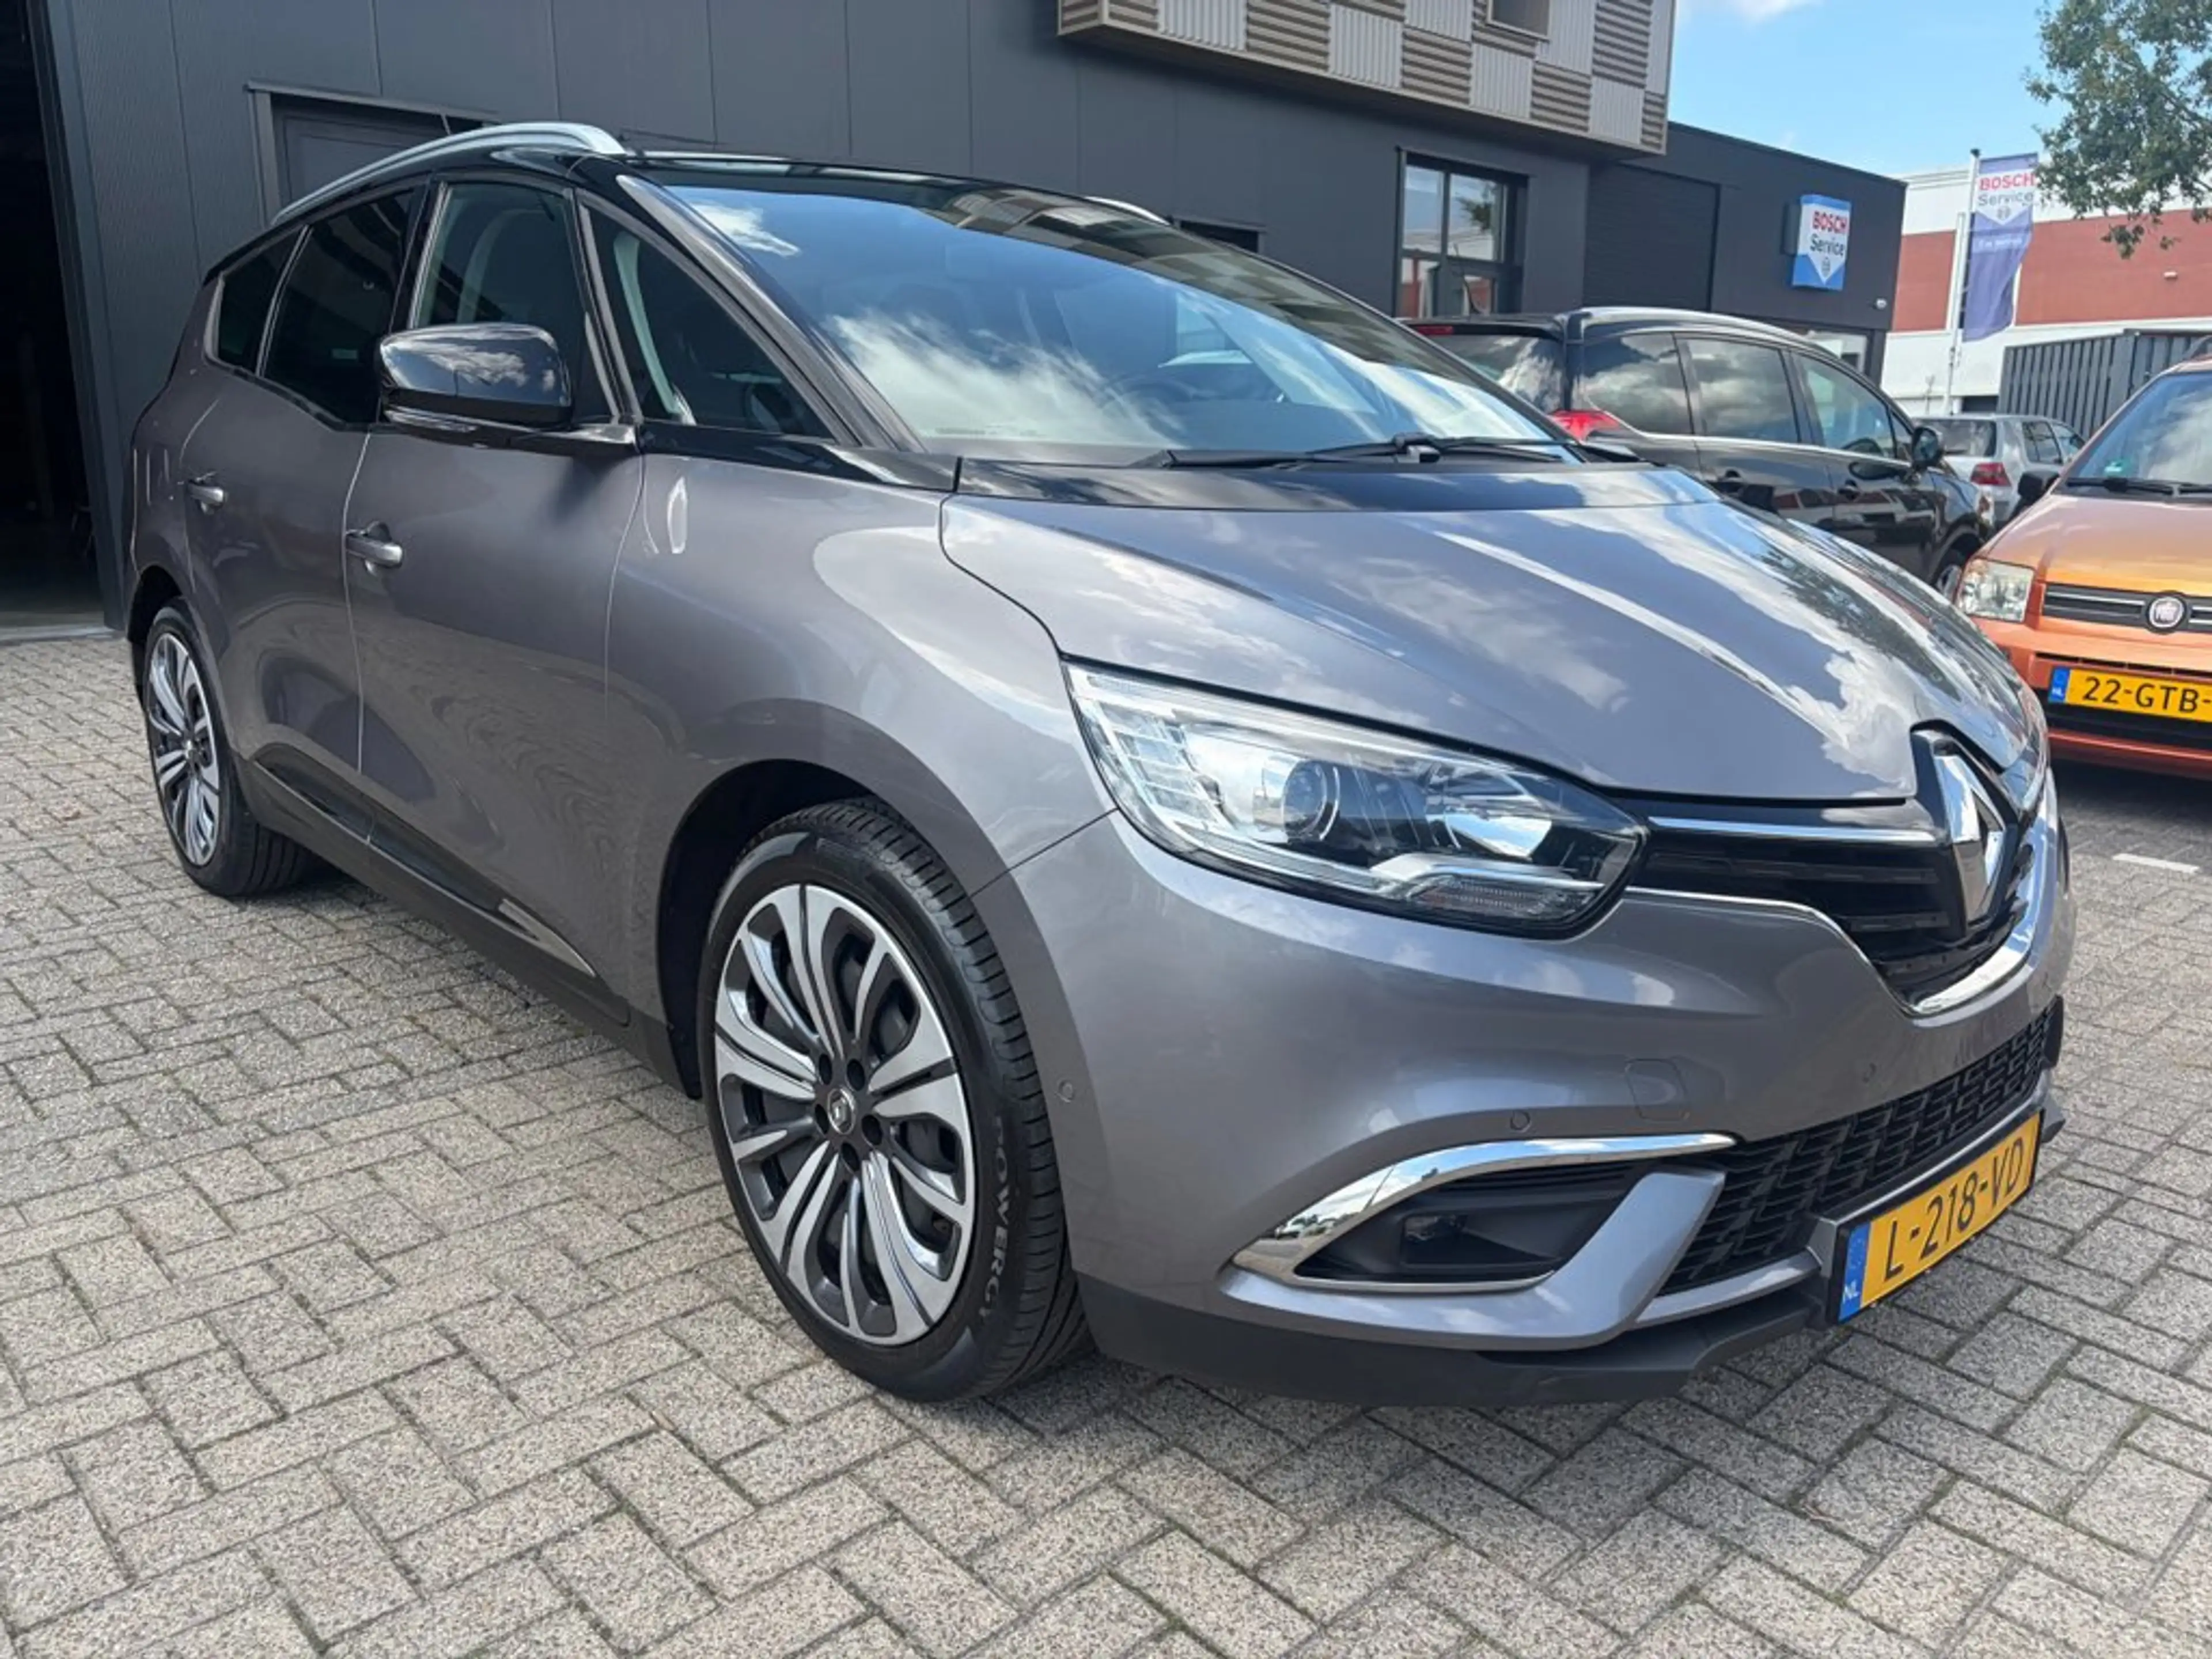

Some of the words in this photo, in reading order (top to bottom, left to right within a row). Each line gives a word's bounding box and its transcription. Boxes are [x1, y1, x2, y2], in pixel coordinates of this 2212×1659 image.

[1979, 173, 2035, 191] BOSCH
[1978, 192, 2034, 206] Service
[1813, 210, 1848, 234] BOSCH
[1810, 233, 1845, 257] Service
[1884, 1137, 2024, 1282] L-218-VD
[1843, 1280, 1859, 1304] NL
